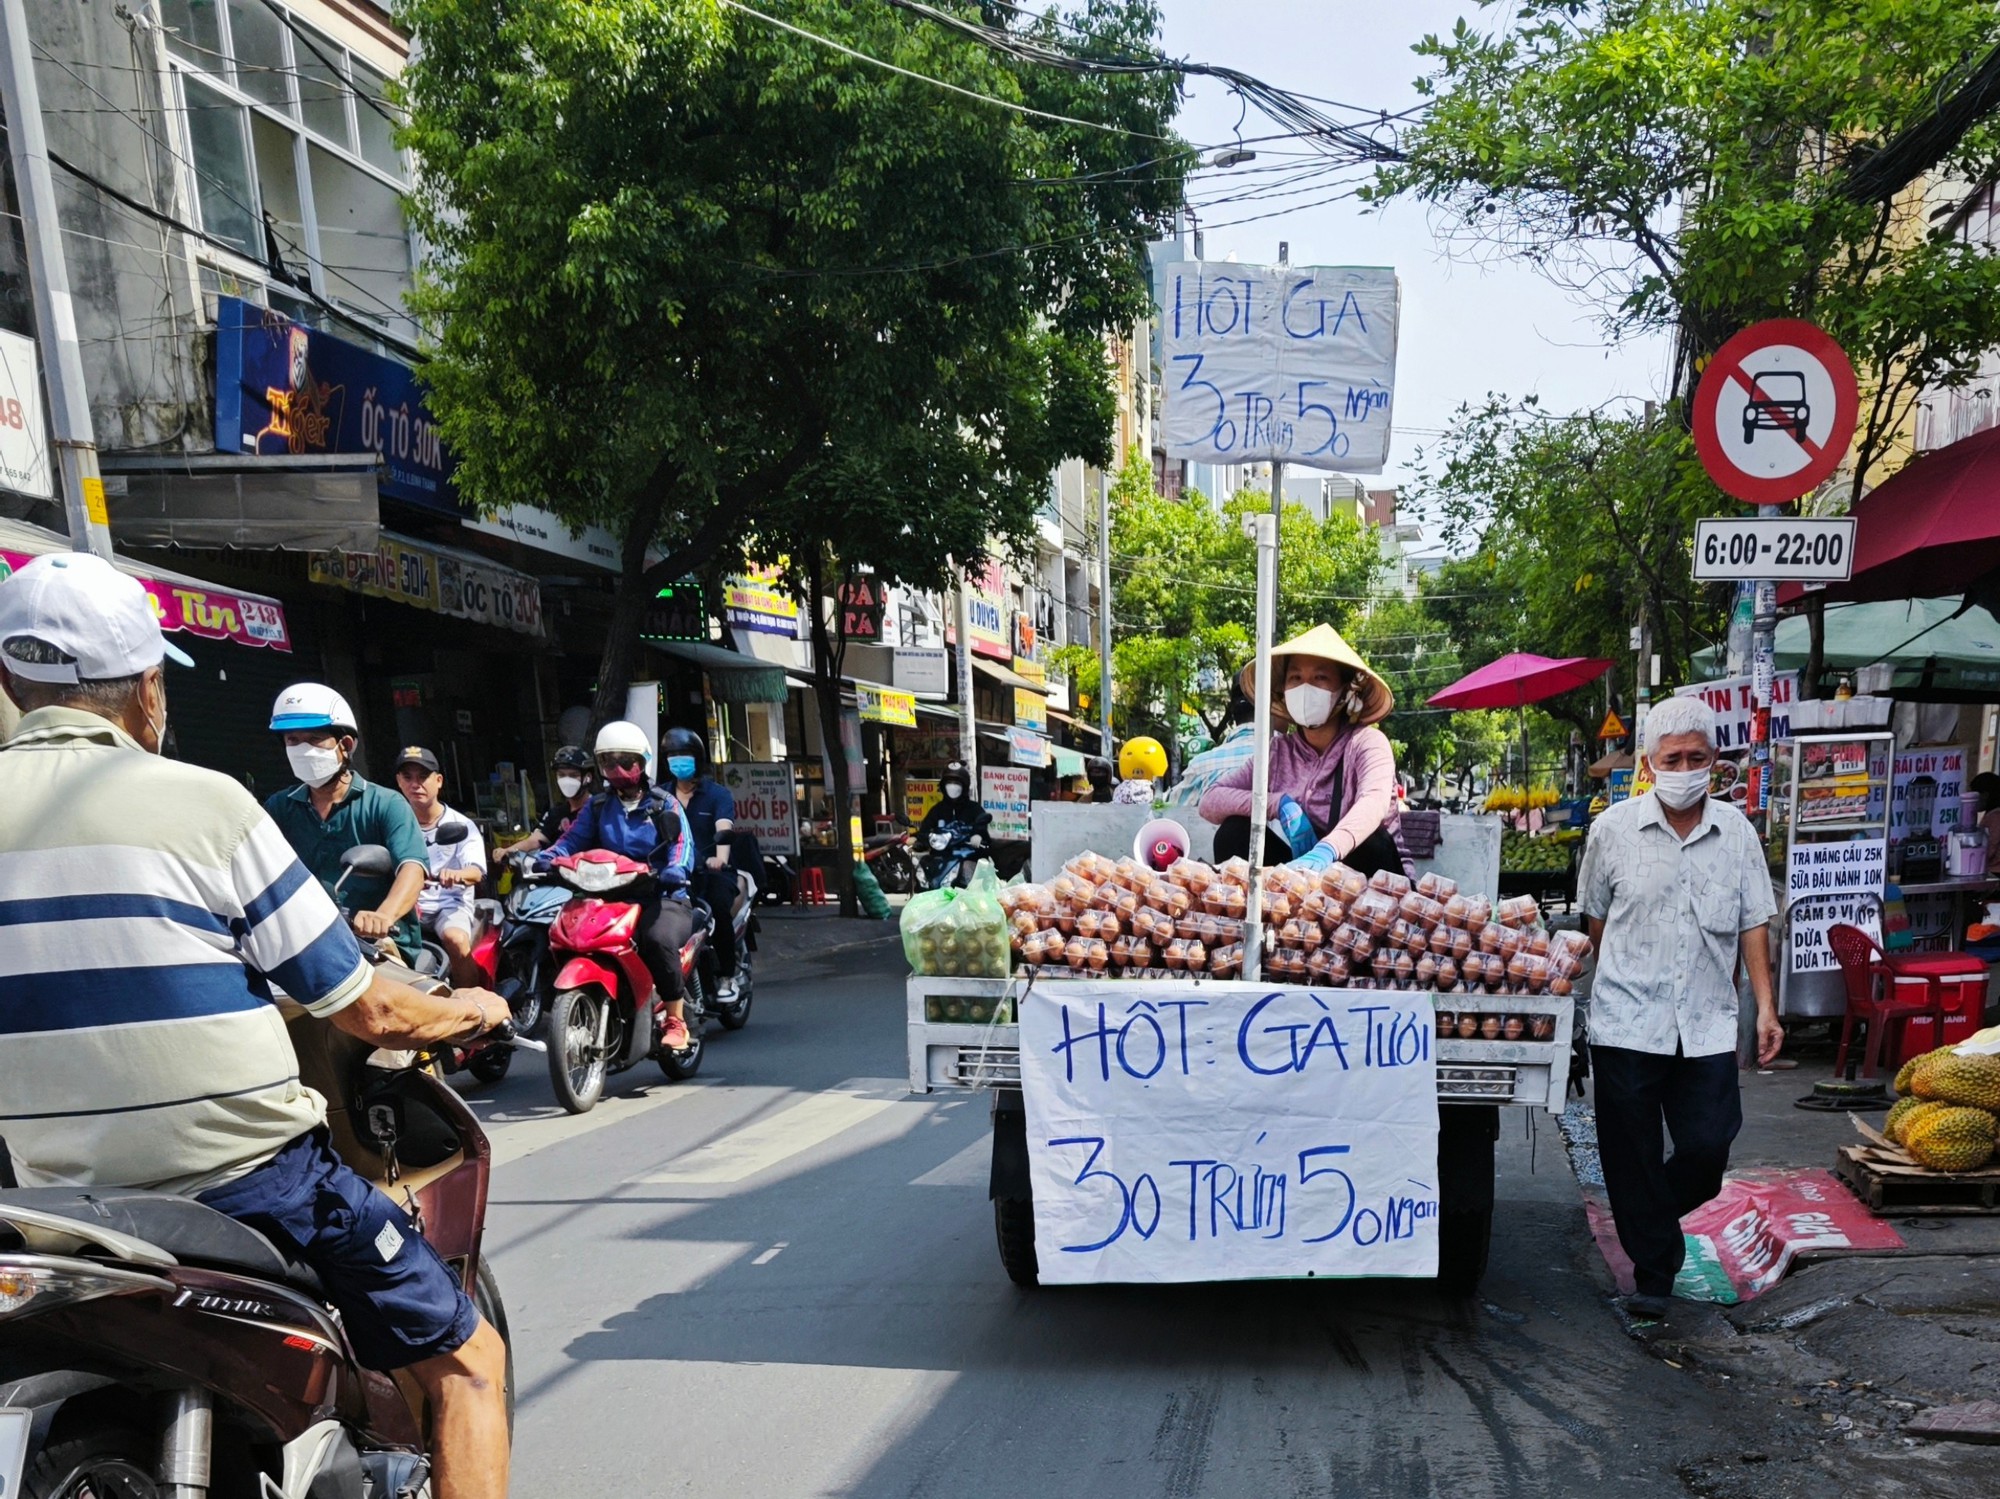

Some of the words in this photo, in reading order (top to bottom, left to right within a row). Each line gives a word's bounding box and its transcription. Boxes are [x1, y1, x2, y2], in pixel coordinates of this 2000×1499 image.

[1283, 274, 1369, 338] GÀ
[1173, 354, 1236, 451] 30
[1298, 381, 1349, 457] 50
[267, 386, 329, 454] Tiger
[362, 387, 385, 451] ỐC
[389, 402, 409, 460] TÔ
[413, 418, 442, 471] 30K
[464, 570, 487, 612] ỐC
[492, 583, 513, 619] TÔ
[172, 589, 240, 633] Tin
[242, 601, 277, 625] 248
[1687, 686, 1732, 714] ÚN
[1738, 676, 1790, 710] TÁI
[1737, 715, 1791, 745] MM
[1892, 754, 1907, 773] RÁI
[1943, 755, 1961, 770] 20K
[1941, 782, 1960, 797] 25K
[771, 795, 789, 820] ÉP
[1940, 808, 1959, 823] 25K
[767, 823, 789, 837] CHẤT
[1793, 848, 1810, 866] TRÀ
[1864, 847, 1883, 861] 25K
[1791, 870, 1809, 890] SỮA
[1812, 868, 1832, 891] ĐẬU
[1835, 866, 1861, 887] NÀNH
[1864, 869, 1882, 885] 10K
[1795, 904, 1824, 922] SÂM
[1828, 906, 1837, 919] 9
[1795, 927, 1822, 948] DỪA
[1796, 950, 1818, 970] DỪA
[1052, 1000, 1209, 1088] HỘT
[1238, 993, 1348, 1075] GÀ
[1048, 1137, 1161, 1252] 30
[1298, 1145, 1382, 1246] 50
